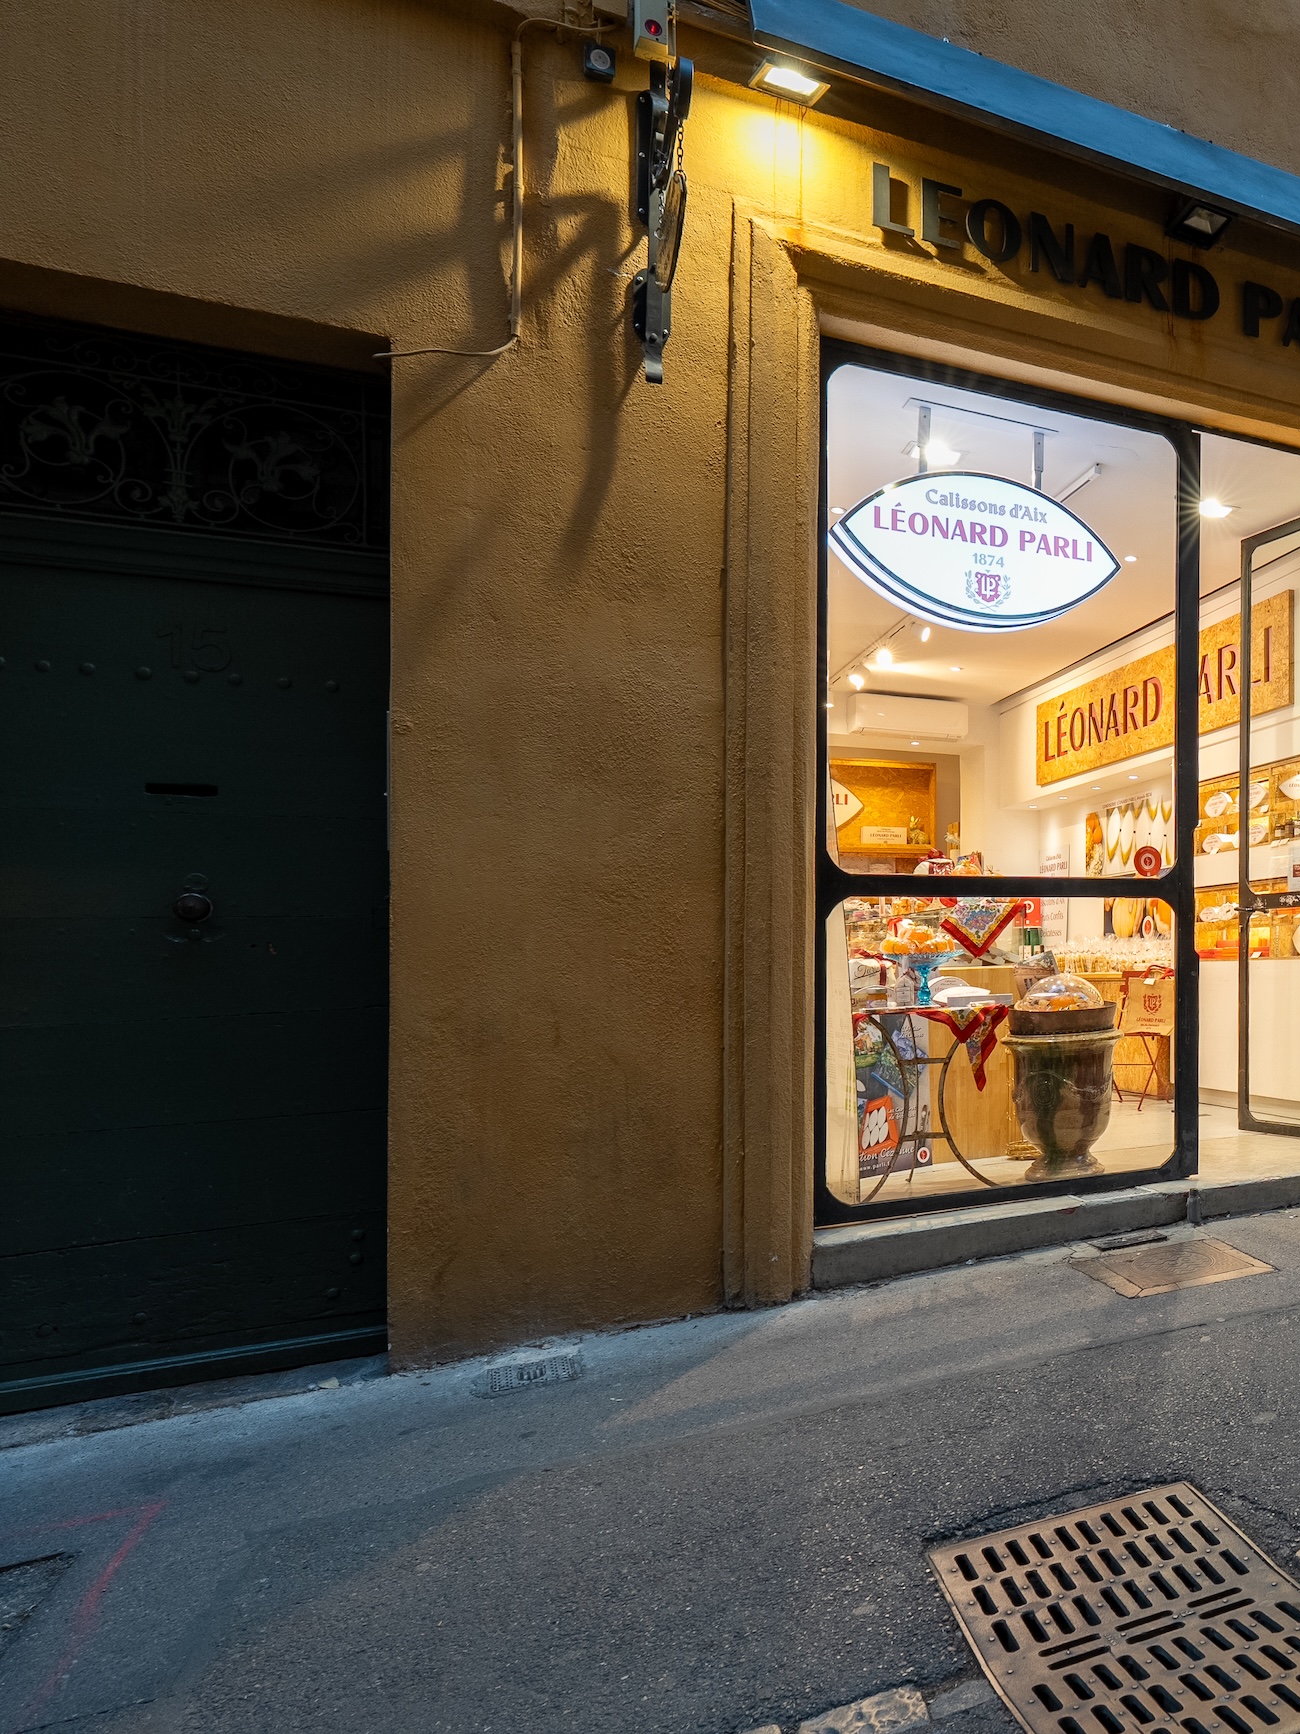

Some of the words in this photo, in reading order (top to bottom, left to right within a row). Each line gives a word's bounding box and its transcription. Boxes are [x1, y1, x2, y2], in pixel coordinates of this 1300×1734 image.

[925, 488, 1007, 517] Calissons
[1008, 503, 1049, 525] d'Aix
[873, 502, 1009, 548] LÉONARD
[1019, 530, 1093, 562] PARLI
[971, 552, 1005, 568] 1874
[1044, 676, 1163, 762] LÉONARD
[1057, 860, 1068, 871] PARLI
